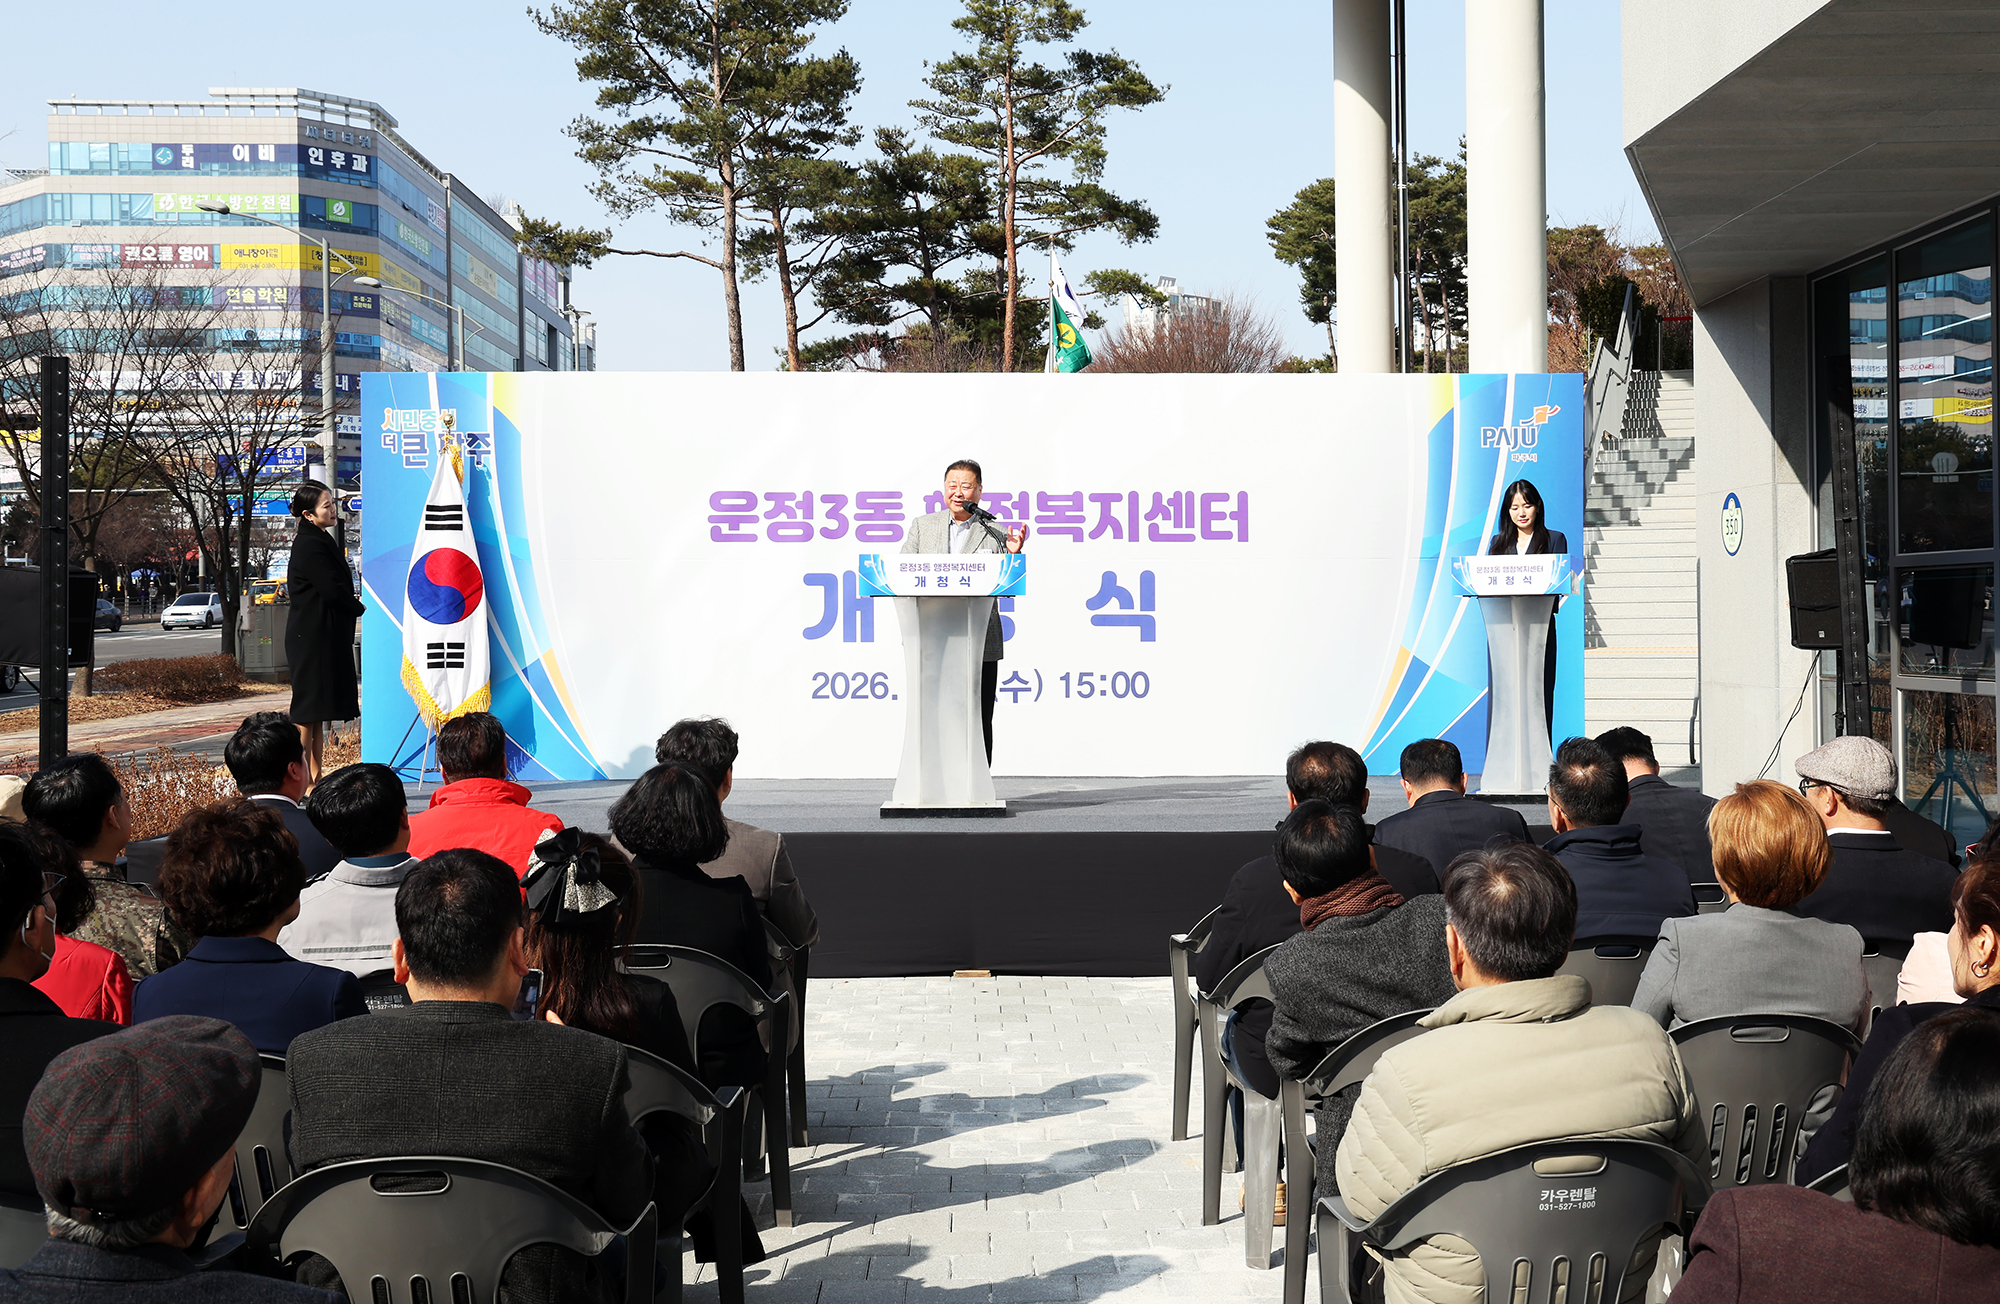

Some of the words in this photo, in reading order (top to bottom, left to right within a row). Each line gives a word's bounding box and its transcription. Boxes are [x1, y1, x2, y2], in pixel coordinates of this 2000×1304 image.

[308, 147, 367, 172] 인후과
[178, 246, 209, 262] 영어
[1482, 427, 1537, 450] PAJU
[383, 434, 396, 453] 더
[402, 433, 428, 466] 큰
[1512, 453, 1537, 462] 파주시
[707, 490, 903, 543] 운정3동
[1725, 518, 1739, 535] 350
[900, 562, 931, 572] 운정3동
[812, 672, 898, 700] 2026.
[995, 669, 1043, 703] 수)
[1060, 671, 1150, 699] 15:00
[1540, 1187, 1597, 1203] 카우렌탈
[1539, 1201, 1596, 1211] 031-527-1800
